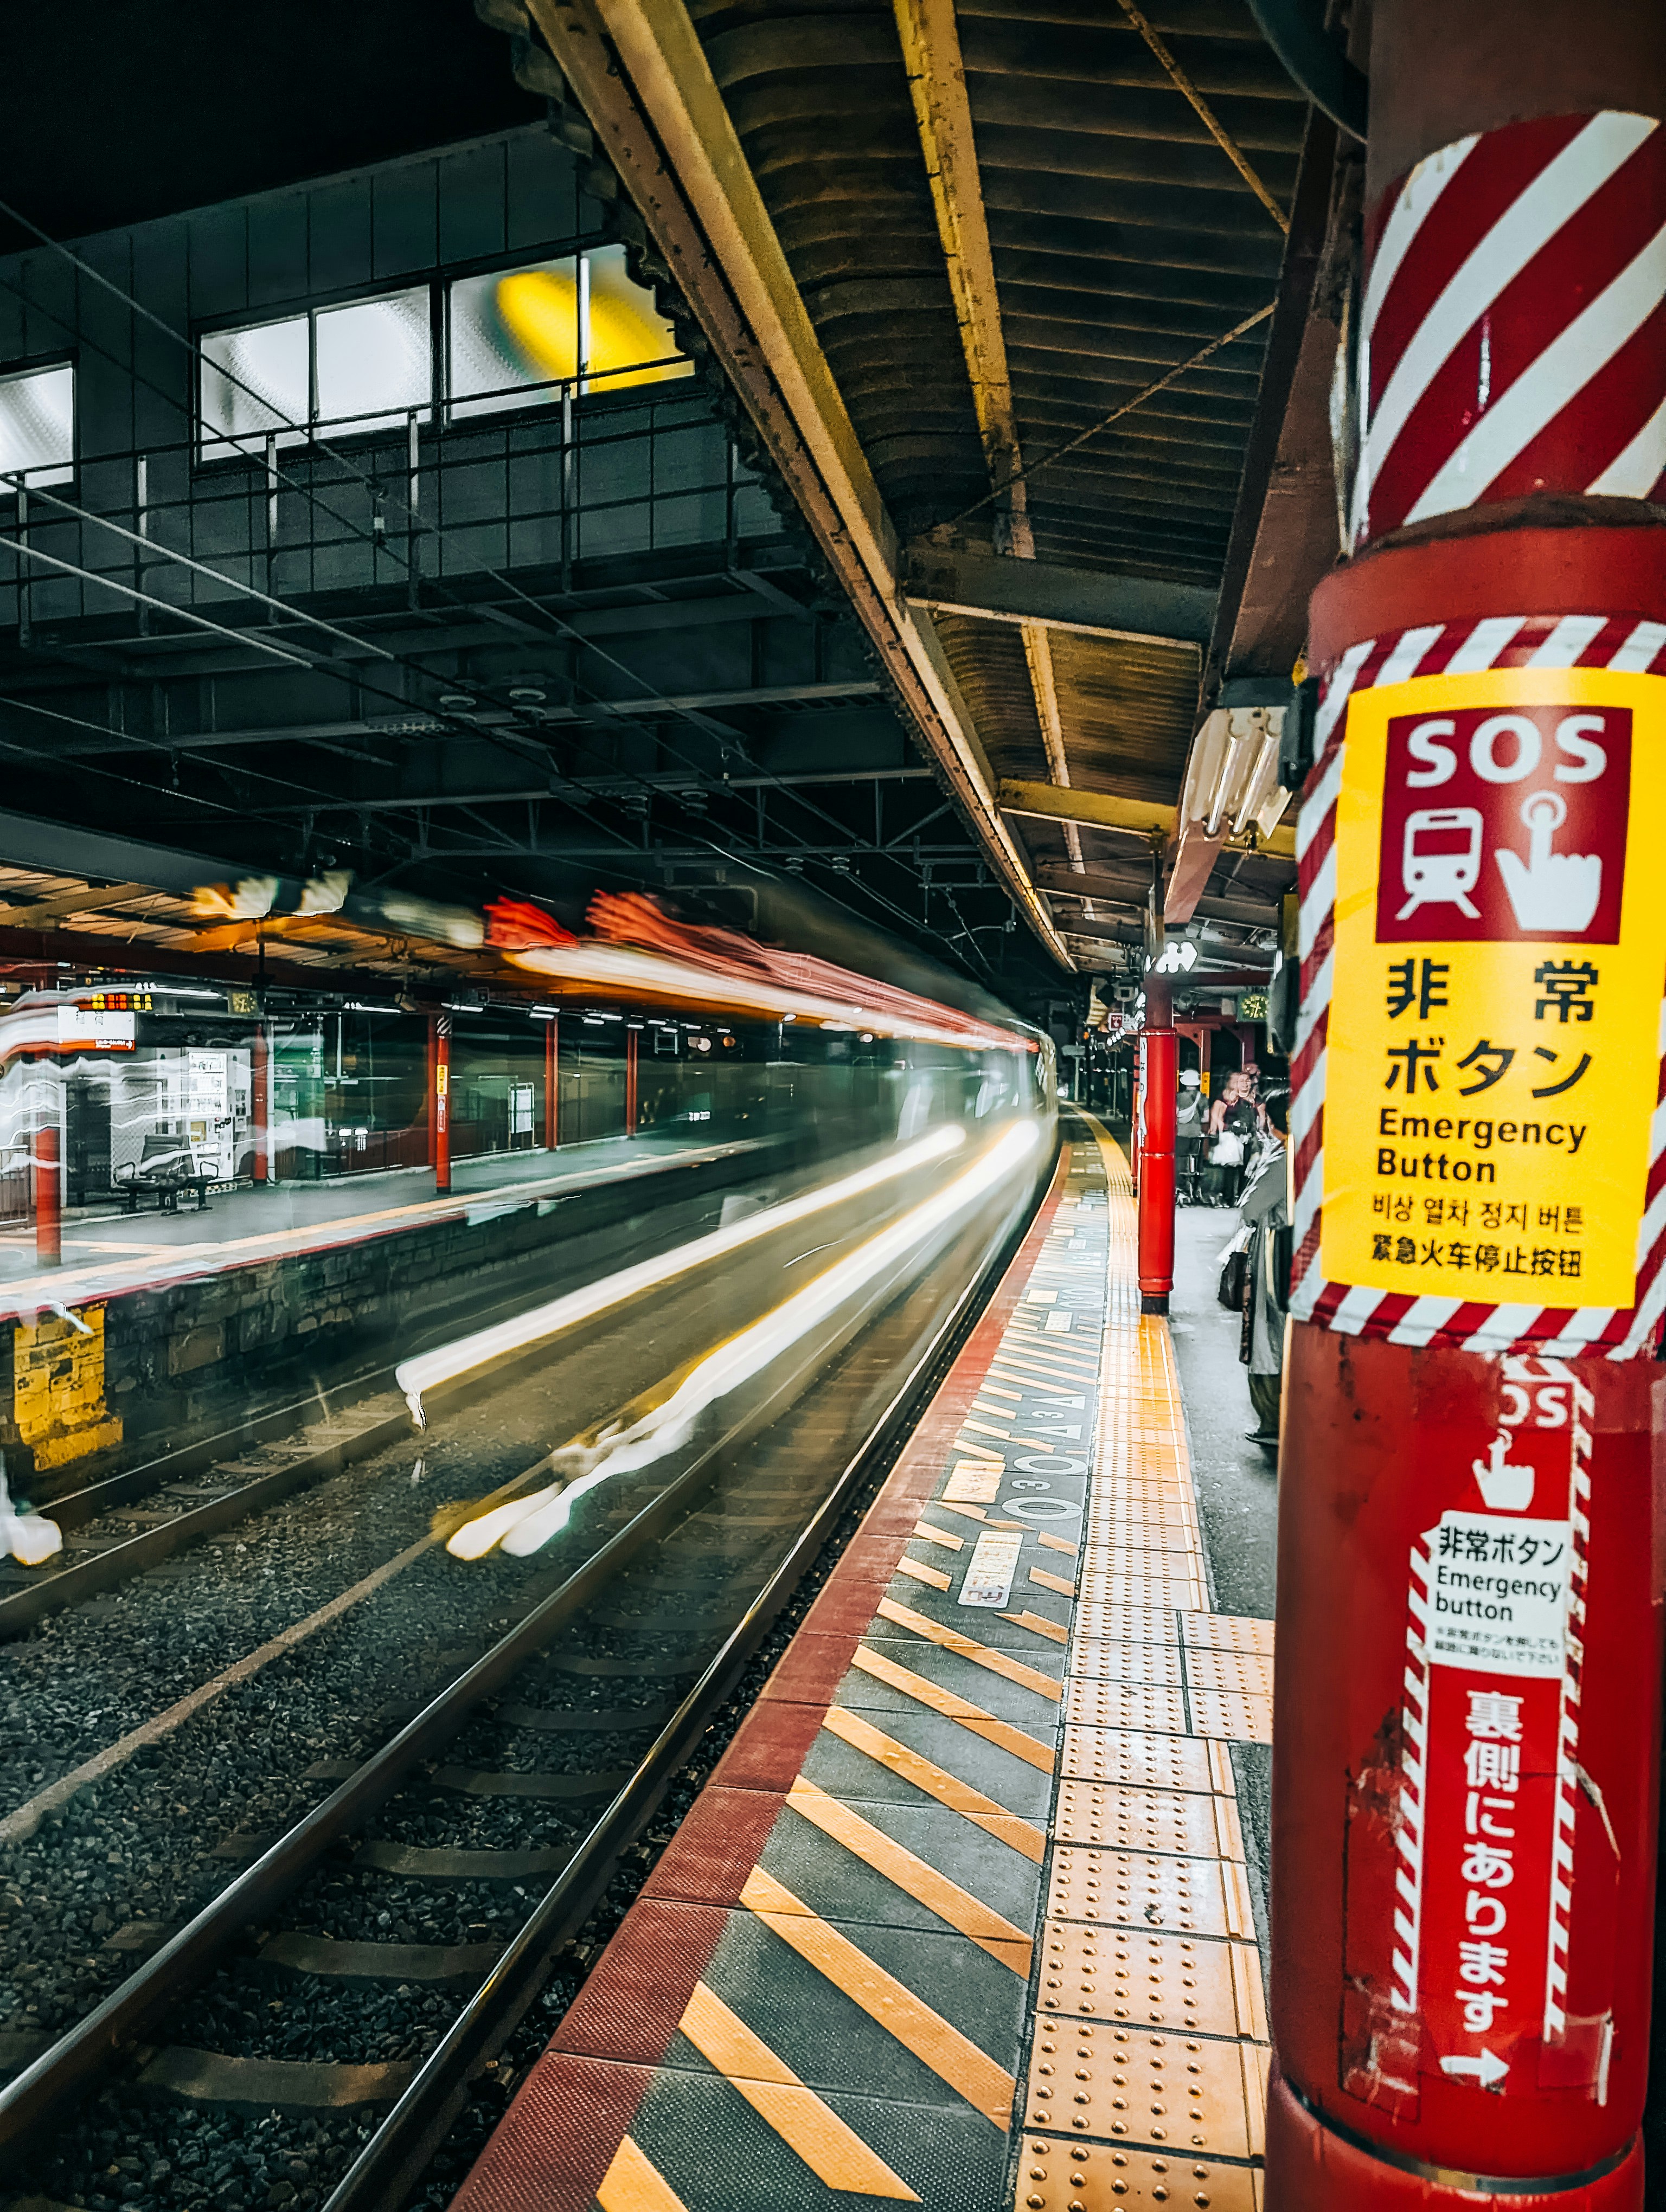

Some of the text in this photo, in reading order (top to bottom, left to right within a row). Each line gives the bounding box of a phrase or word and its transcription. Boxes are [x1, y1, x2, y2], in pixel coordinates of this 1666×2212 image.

[1406, 715, 1607, 788] SOS
[1385, 1037, 1592, 1098] ボタン
[1380, 1108, 1587, 1154] Emergency
[1377, 1148, 1496, 1183] Button
[1373, 1194, 1583, 1234] 비상 열차 정지 버튼
[1439, 1526, 1564, 1566] 非常ボタン
[1437, 1566, 1561, 1603] Emergency
[1436, 1593, 1513, 1623] button
[1454, 1690, 1524, 2033] 裏側にあります
